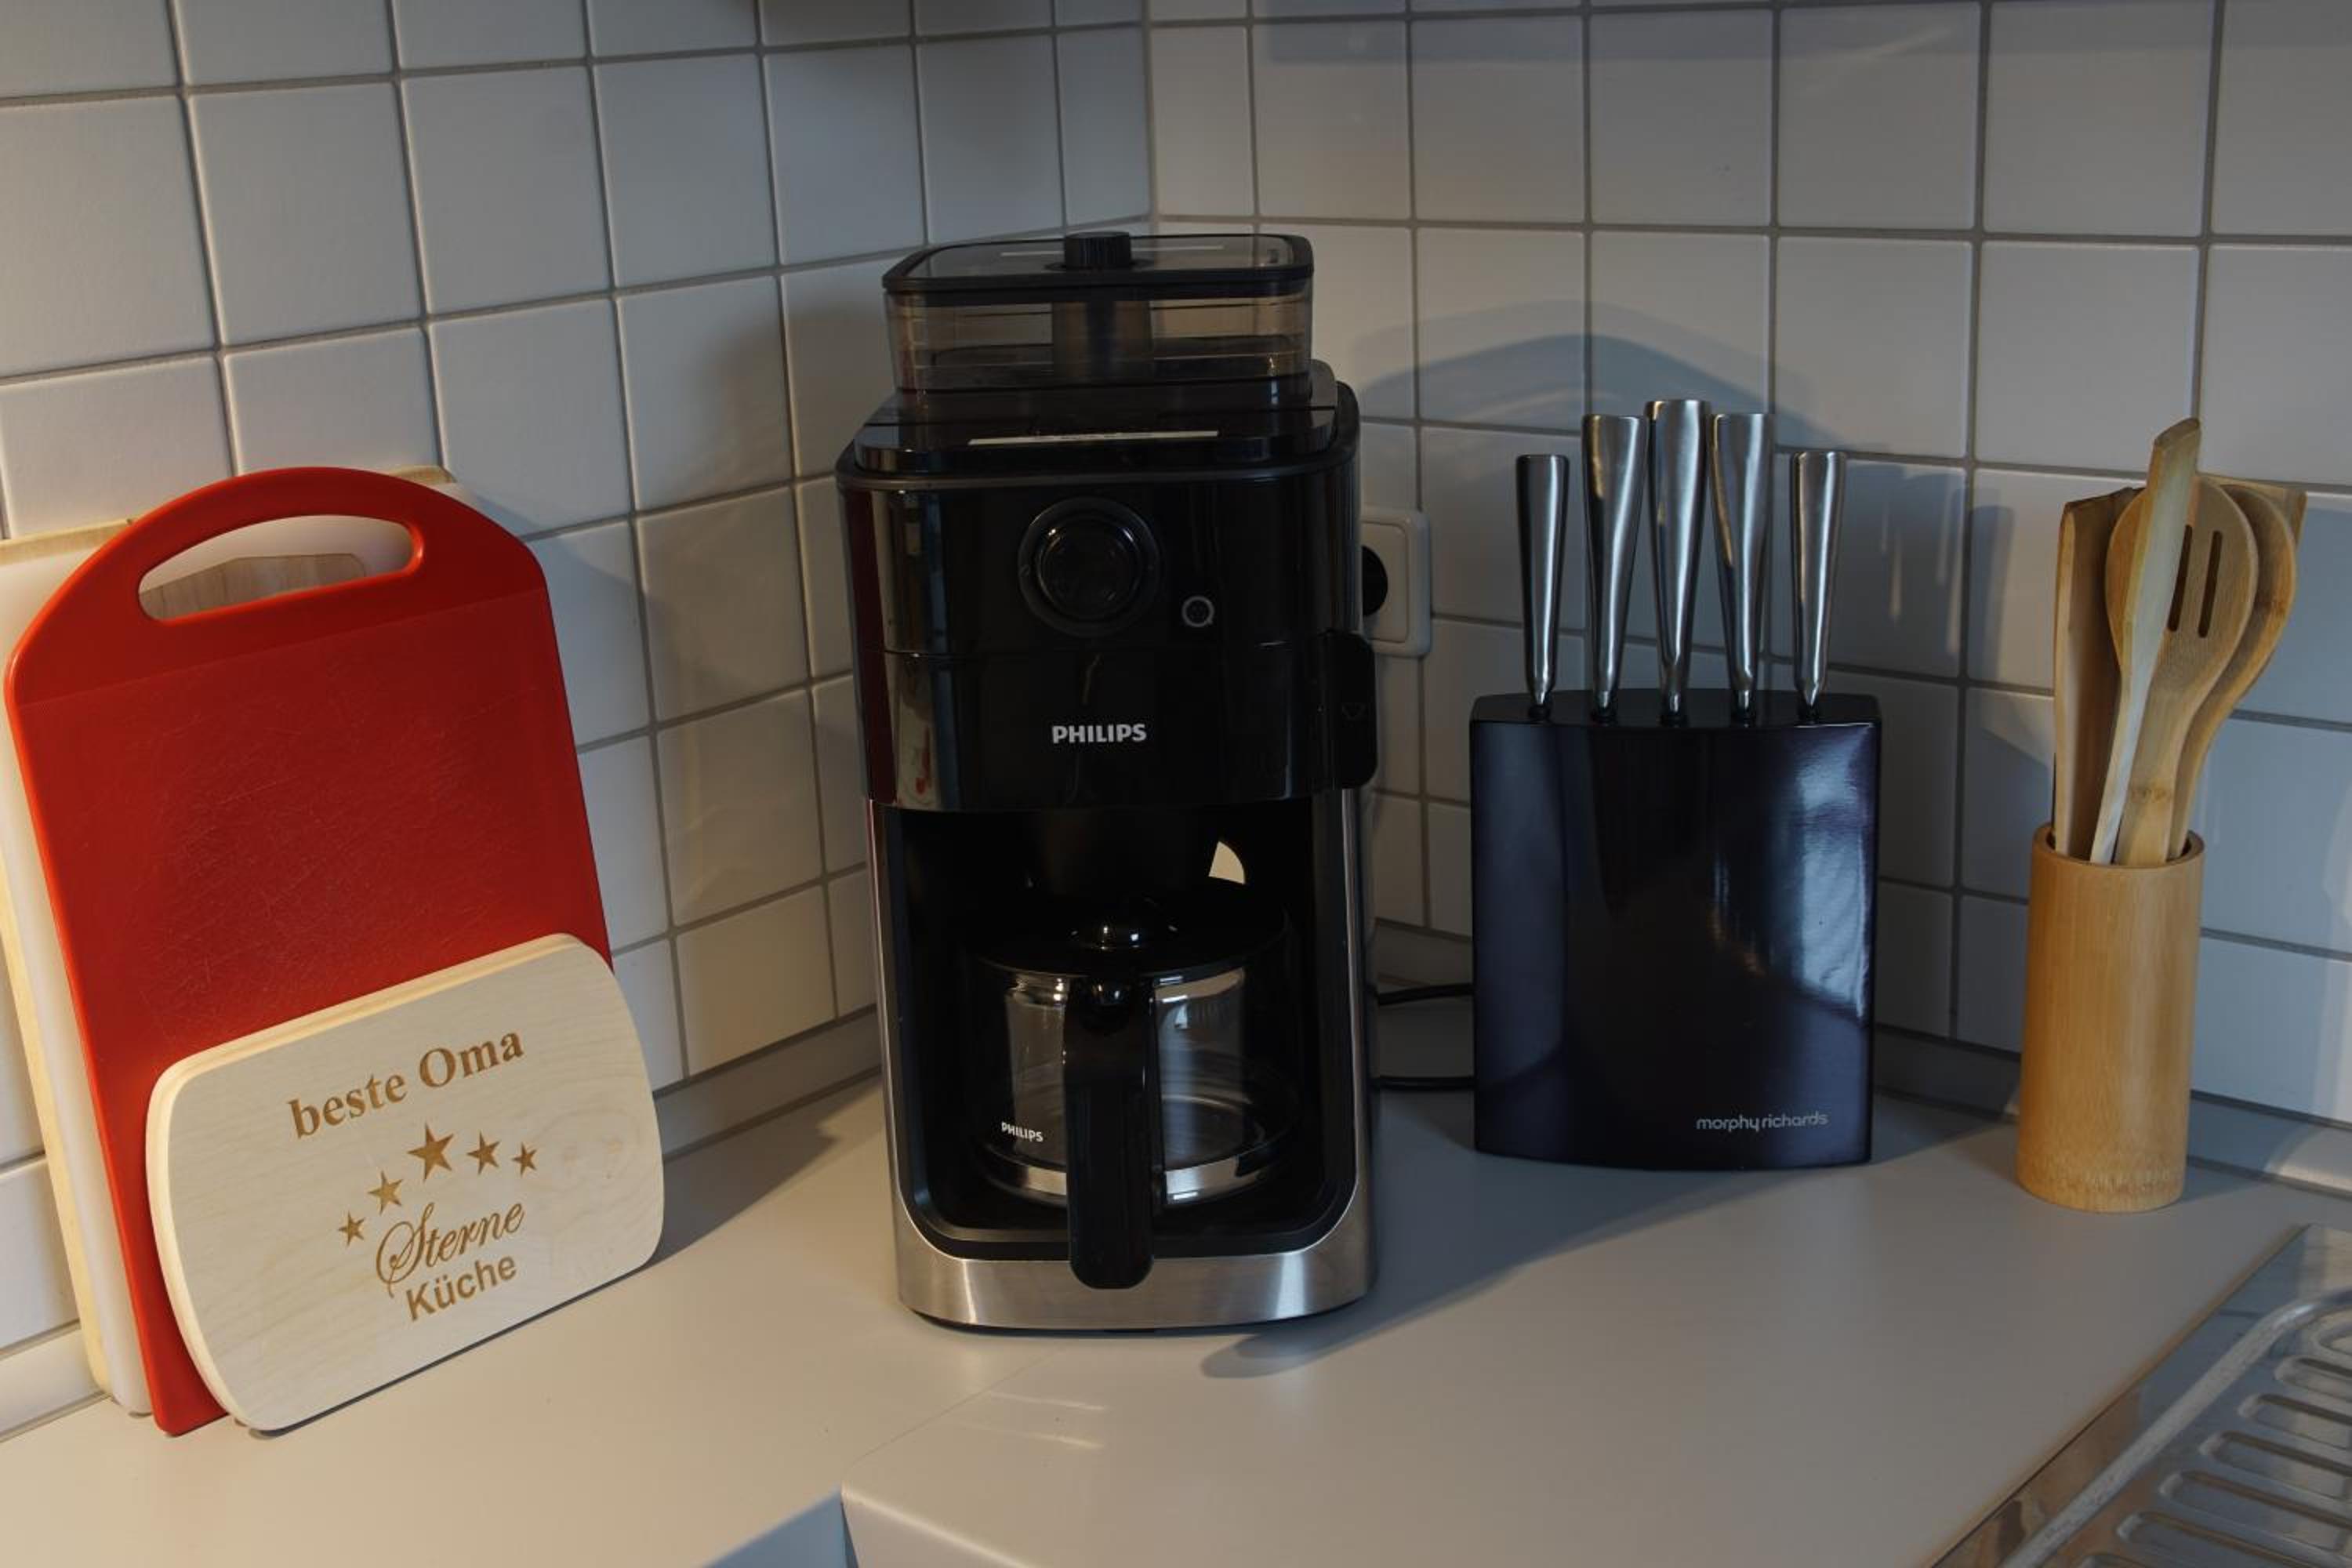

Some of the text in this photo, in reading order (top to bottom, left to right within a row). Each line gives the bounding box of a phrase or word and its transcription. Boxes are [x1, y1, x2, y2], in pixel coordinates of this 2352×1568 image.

[1052, 723, 1147, 743] PHILIPS
[288, 1032, 525, 1138] beste Oma
[1001, 1121, 1044, 1142] PHILIPS
[1696, 1110, 1829, 1133] morphy richards
[376, 1202, 525, 1298] Sterne
[405, 1256, 517, 1322] Küche
